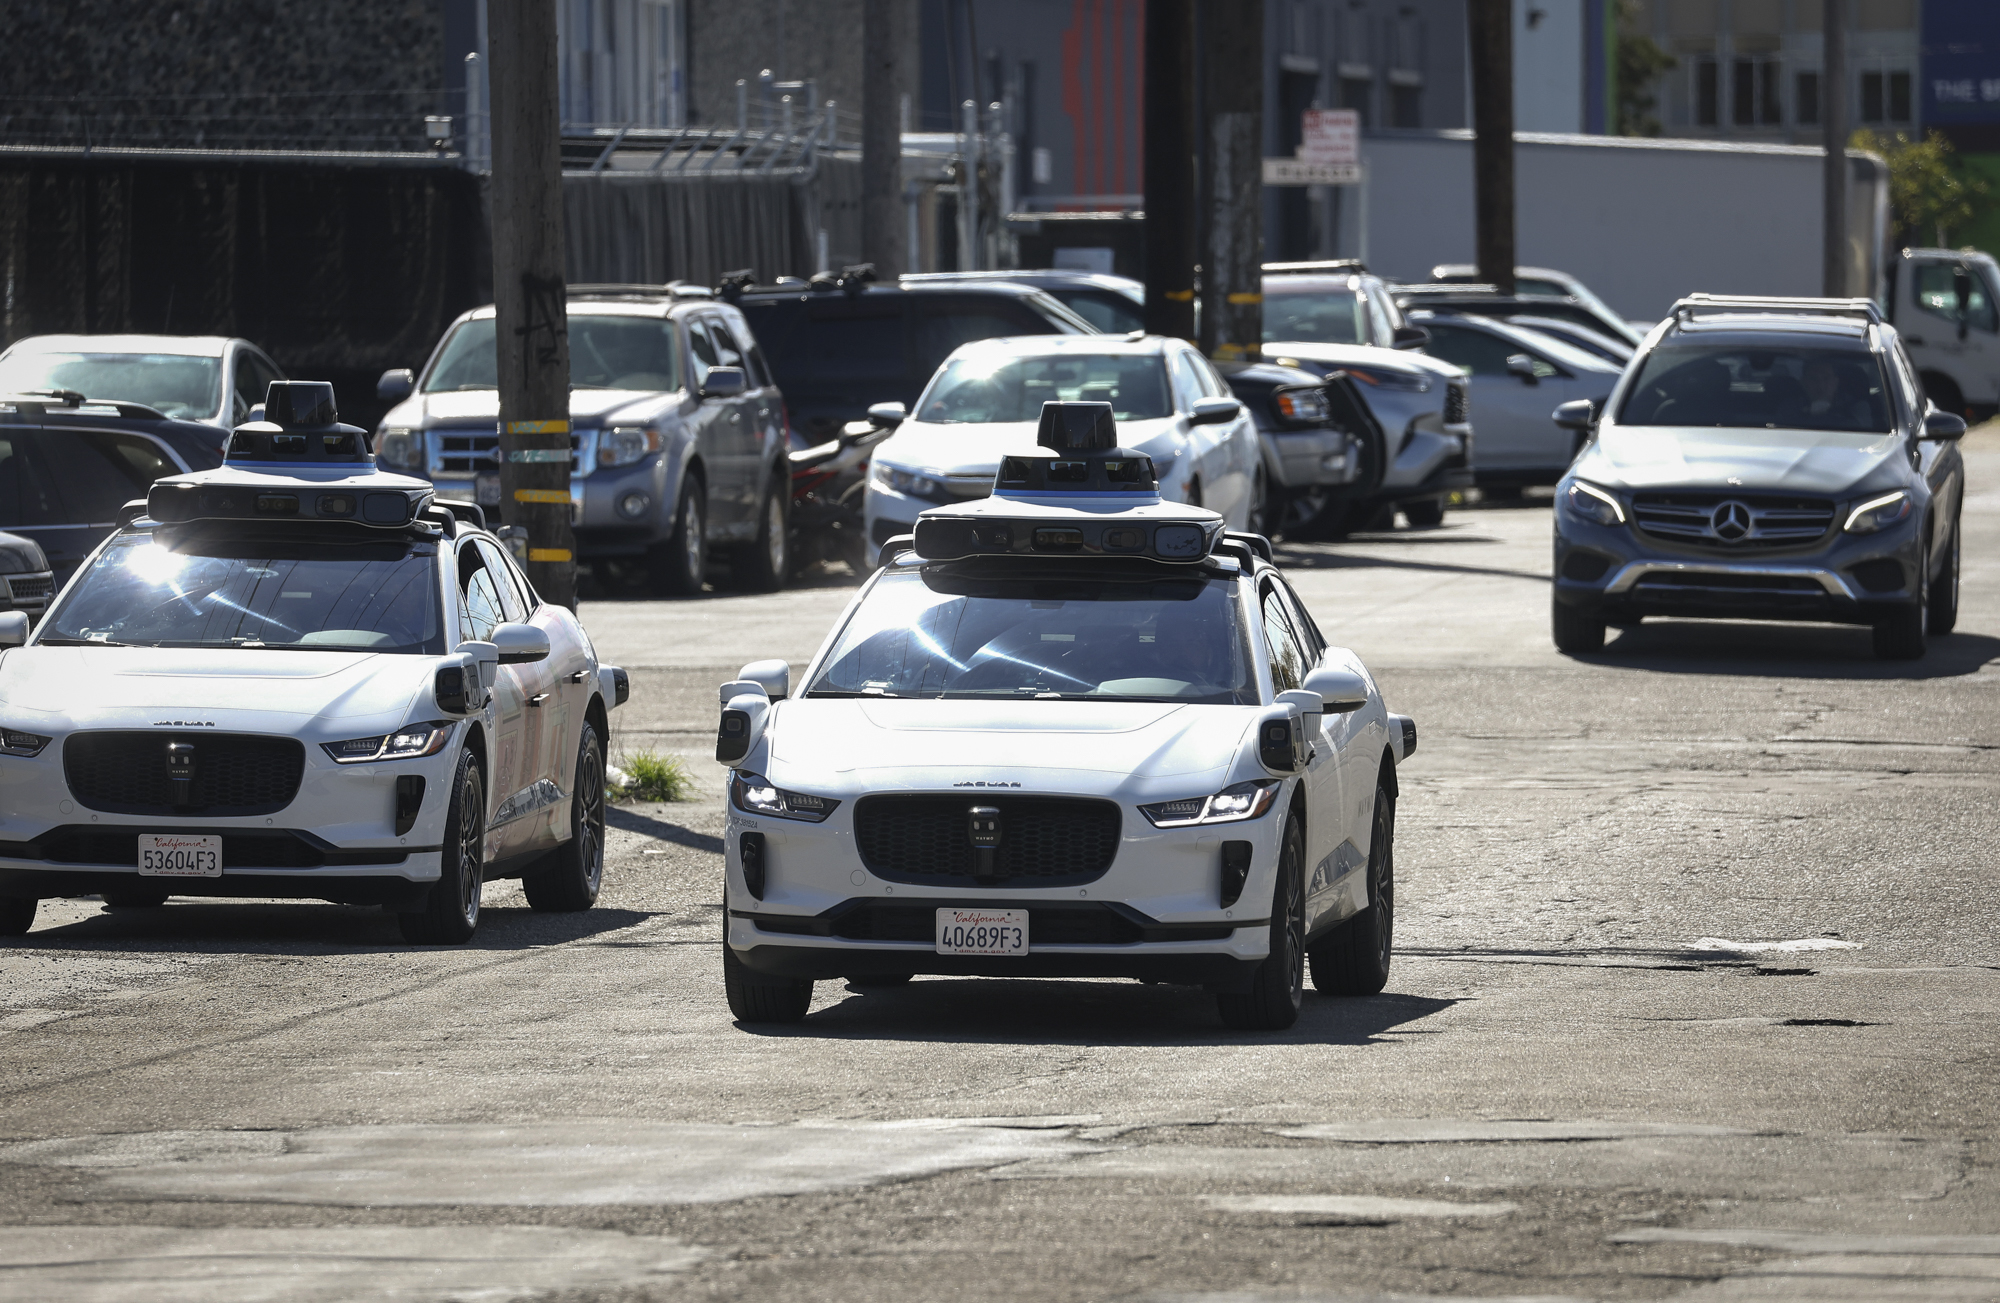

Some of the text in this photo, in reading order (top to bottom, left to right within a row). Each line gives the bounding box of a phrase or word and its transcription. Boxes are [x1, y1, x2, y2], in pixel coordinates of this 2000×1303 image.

[155, 838, 207, 850] California
[144, 850, 216, 870] 53604F3
[956, 911, 1012, 926] California
[943, 926, 1022, 948] 40689F3
